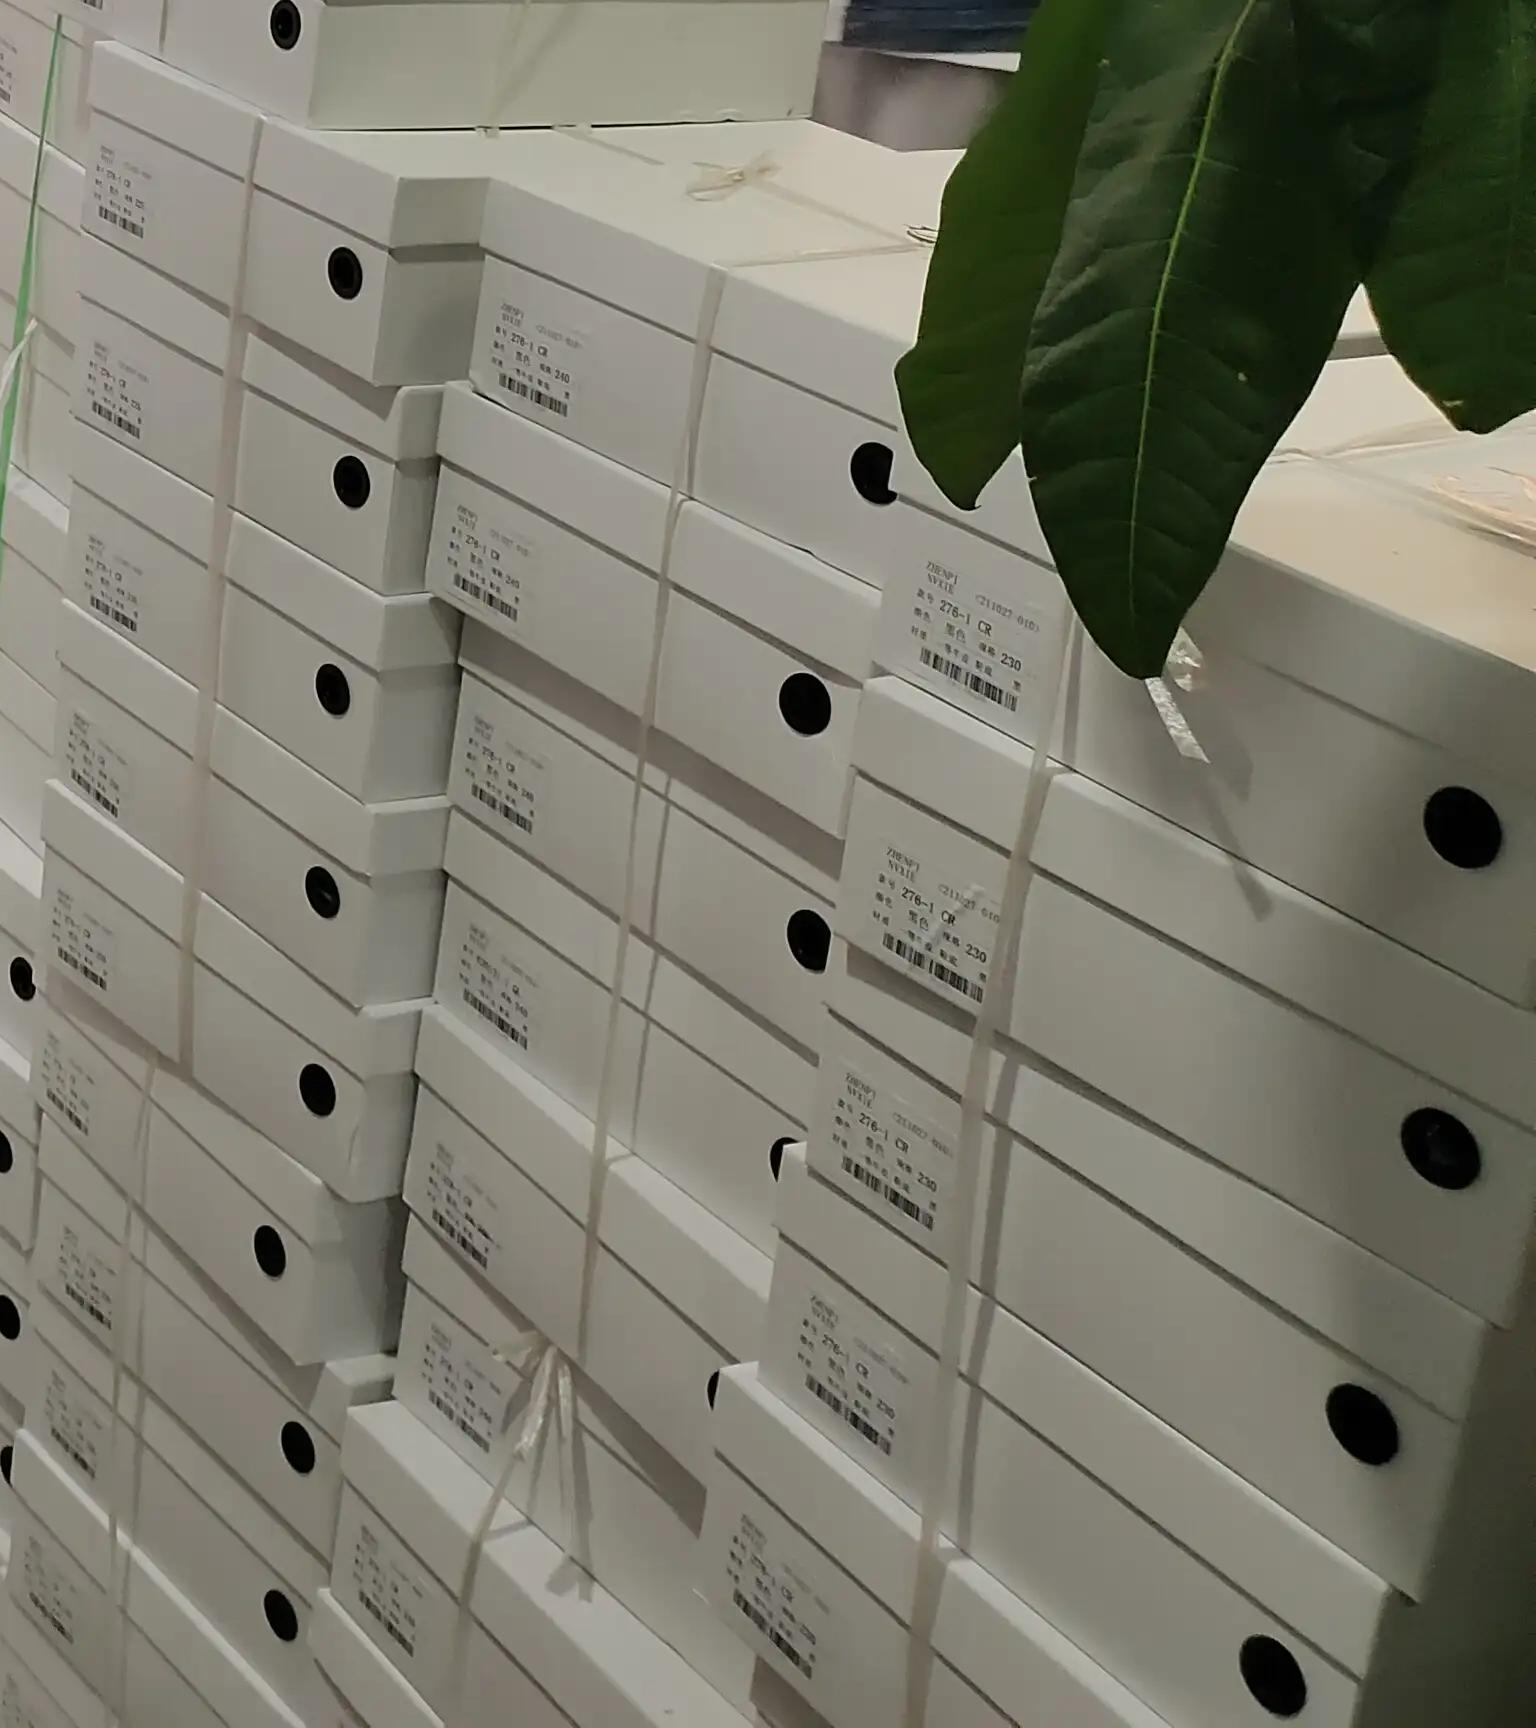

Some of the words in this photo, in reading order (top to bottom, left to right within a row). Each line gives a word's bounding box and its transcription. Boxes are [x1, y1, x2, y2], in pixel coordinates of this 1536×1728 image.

[977, 620, 992, 637] CR
[1000, 652, 1022, 672] 230
[941, 910, 956, 927] CR
[965, 943, 988, 964] 230
